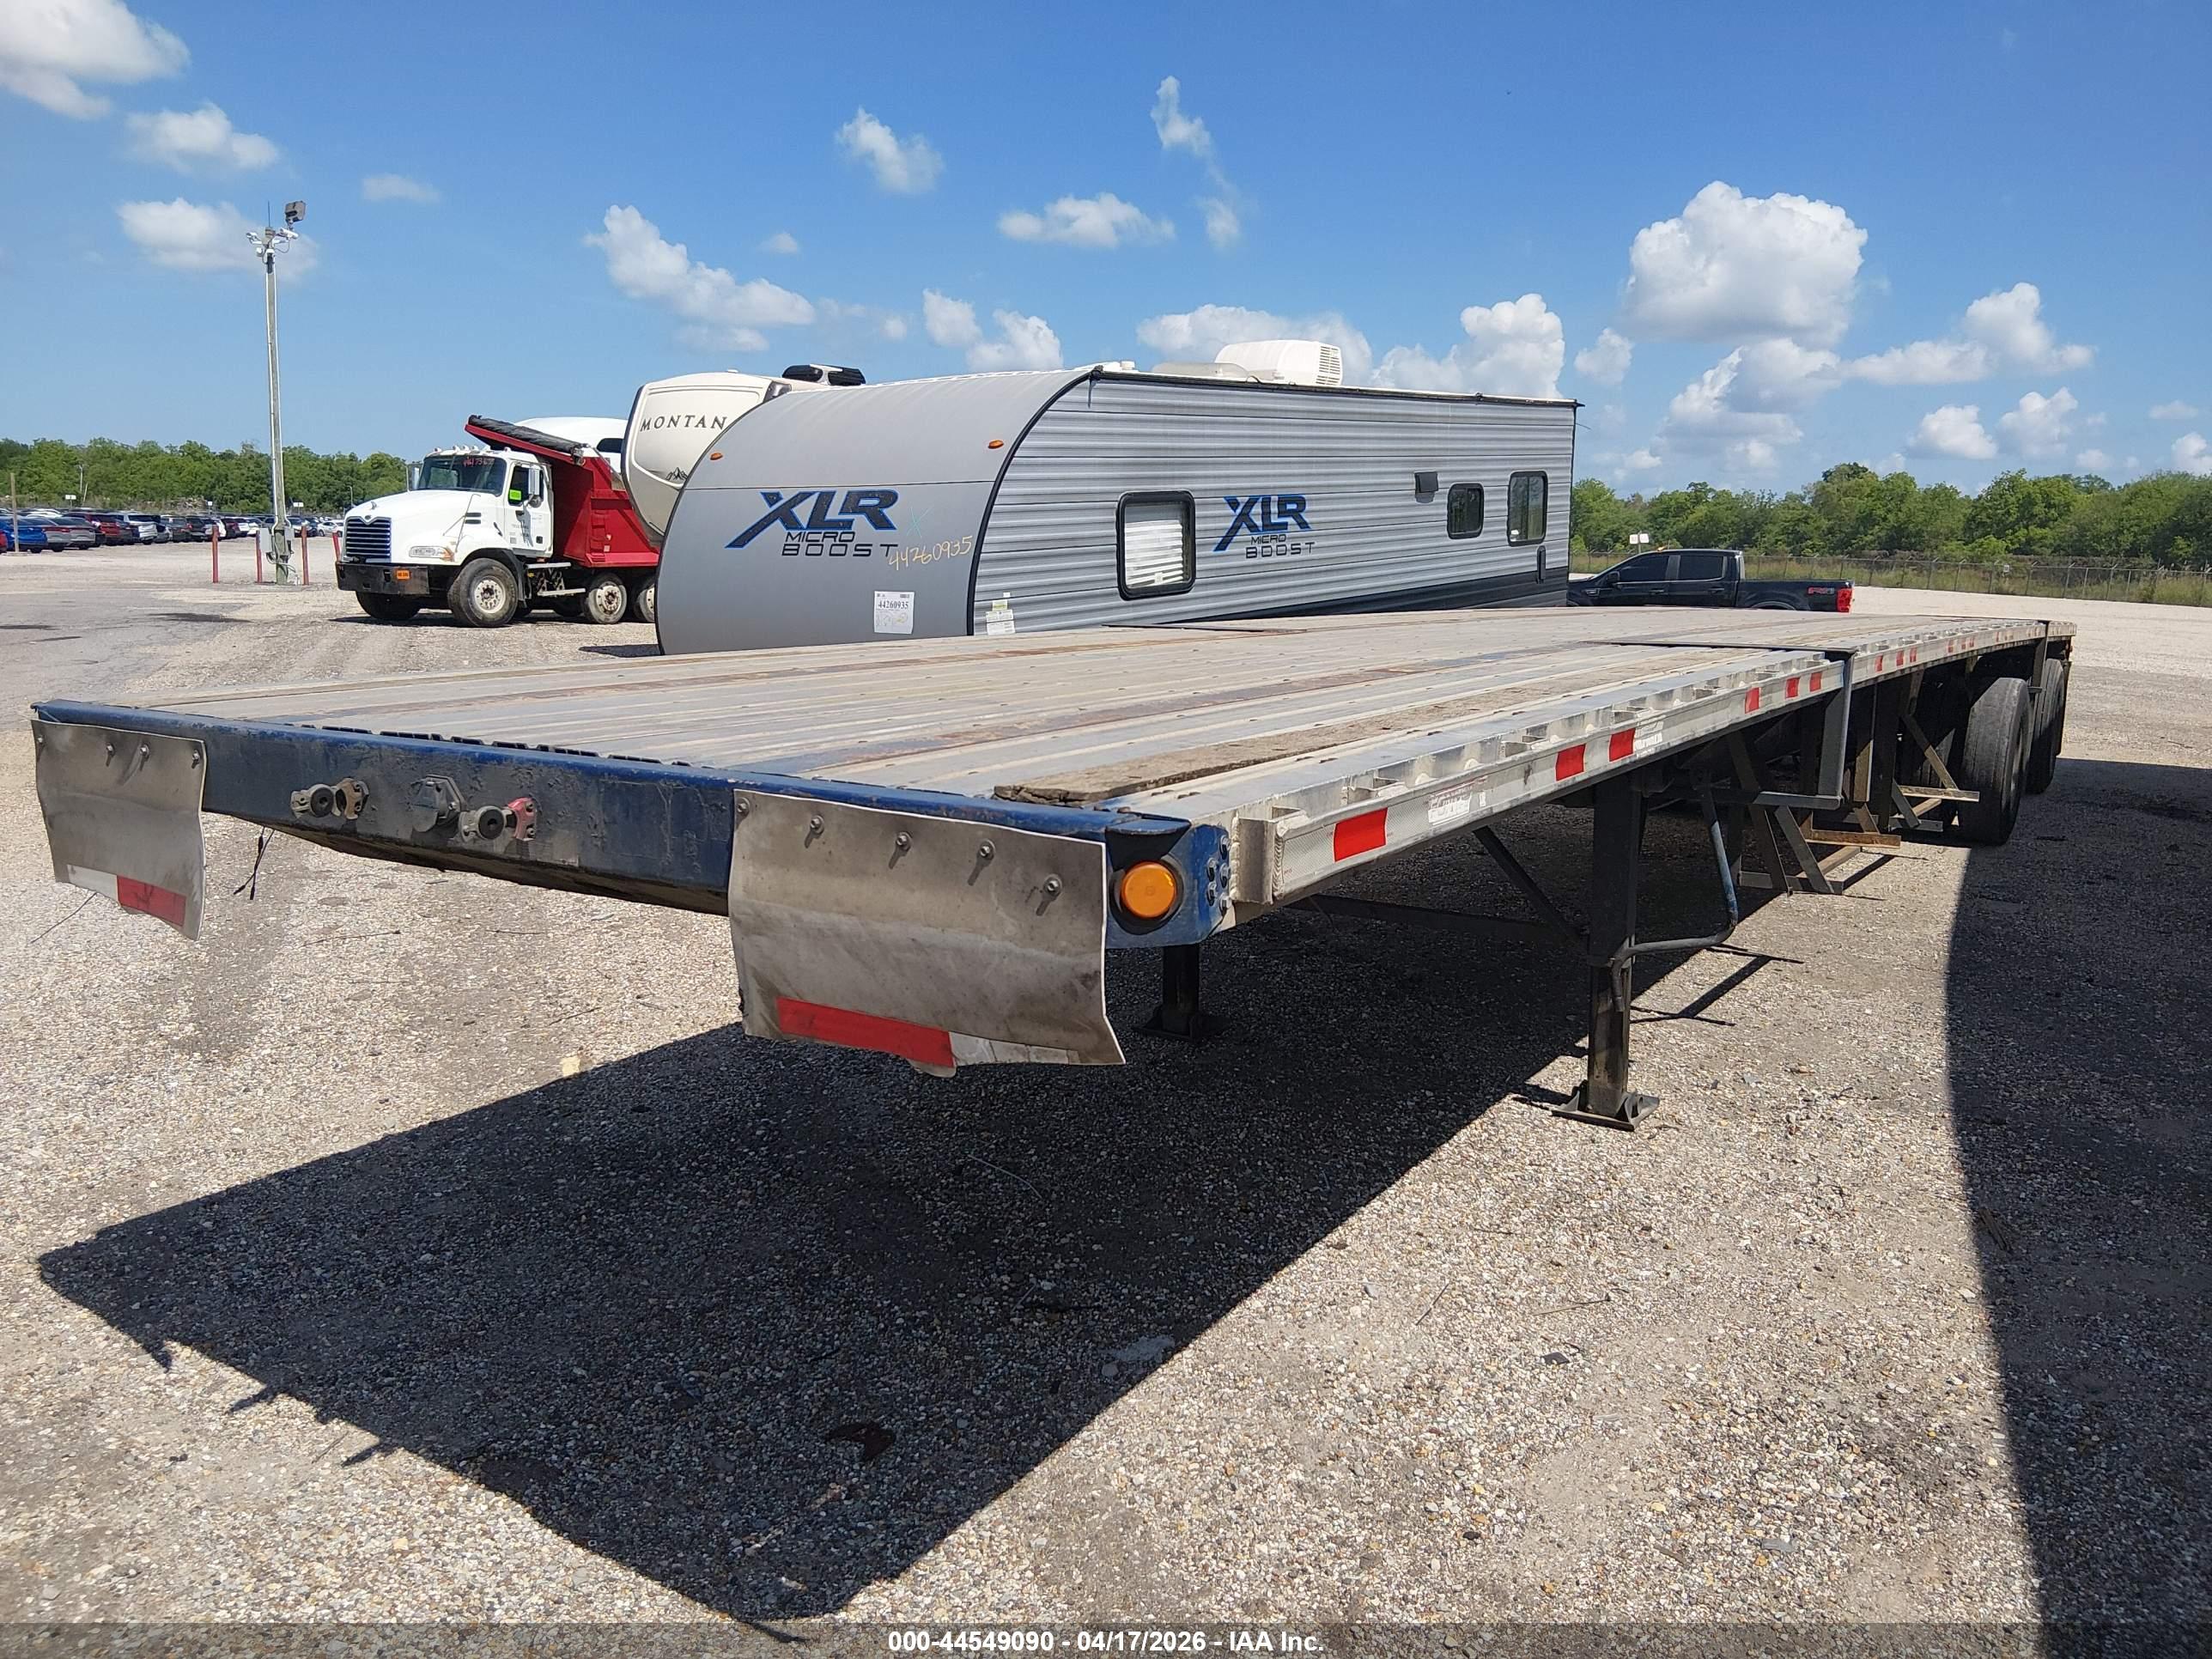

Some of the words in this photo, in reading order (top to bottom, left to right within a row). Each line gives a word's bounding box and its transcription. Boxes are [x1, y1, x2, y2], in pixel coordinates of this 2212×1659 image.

[725, 490, 898, 548] XLR
[1212, 495, 1311, 551] XLR
[785, 532, 855, 542] MICRO
[1251, 534, 1286, 544] MICRO
[781, 544, 898, 556] BOOST
[889, 535, 972, 570] 44260935
[1246, 542, 1315, 558] BOOST
